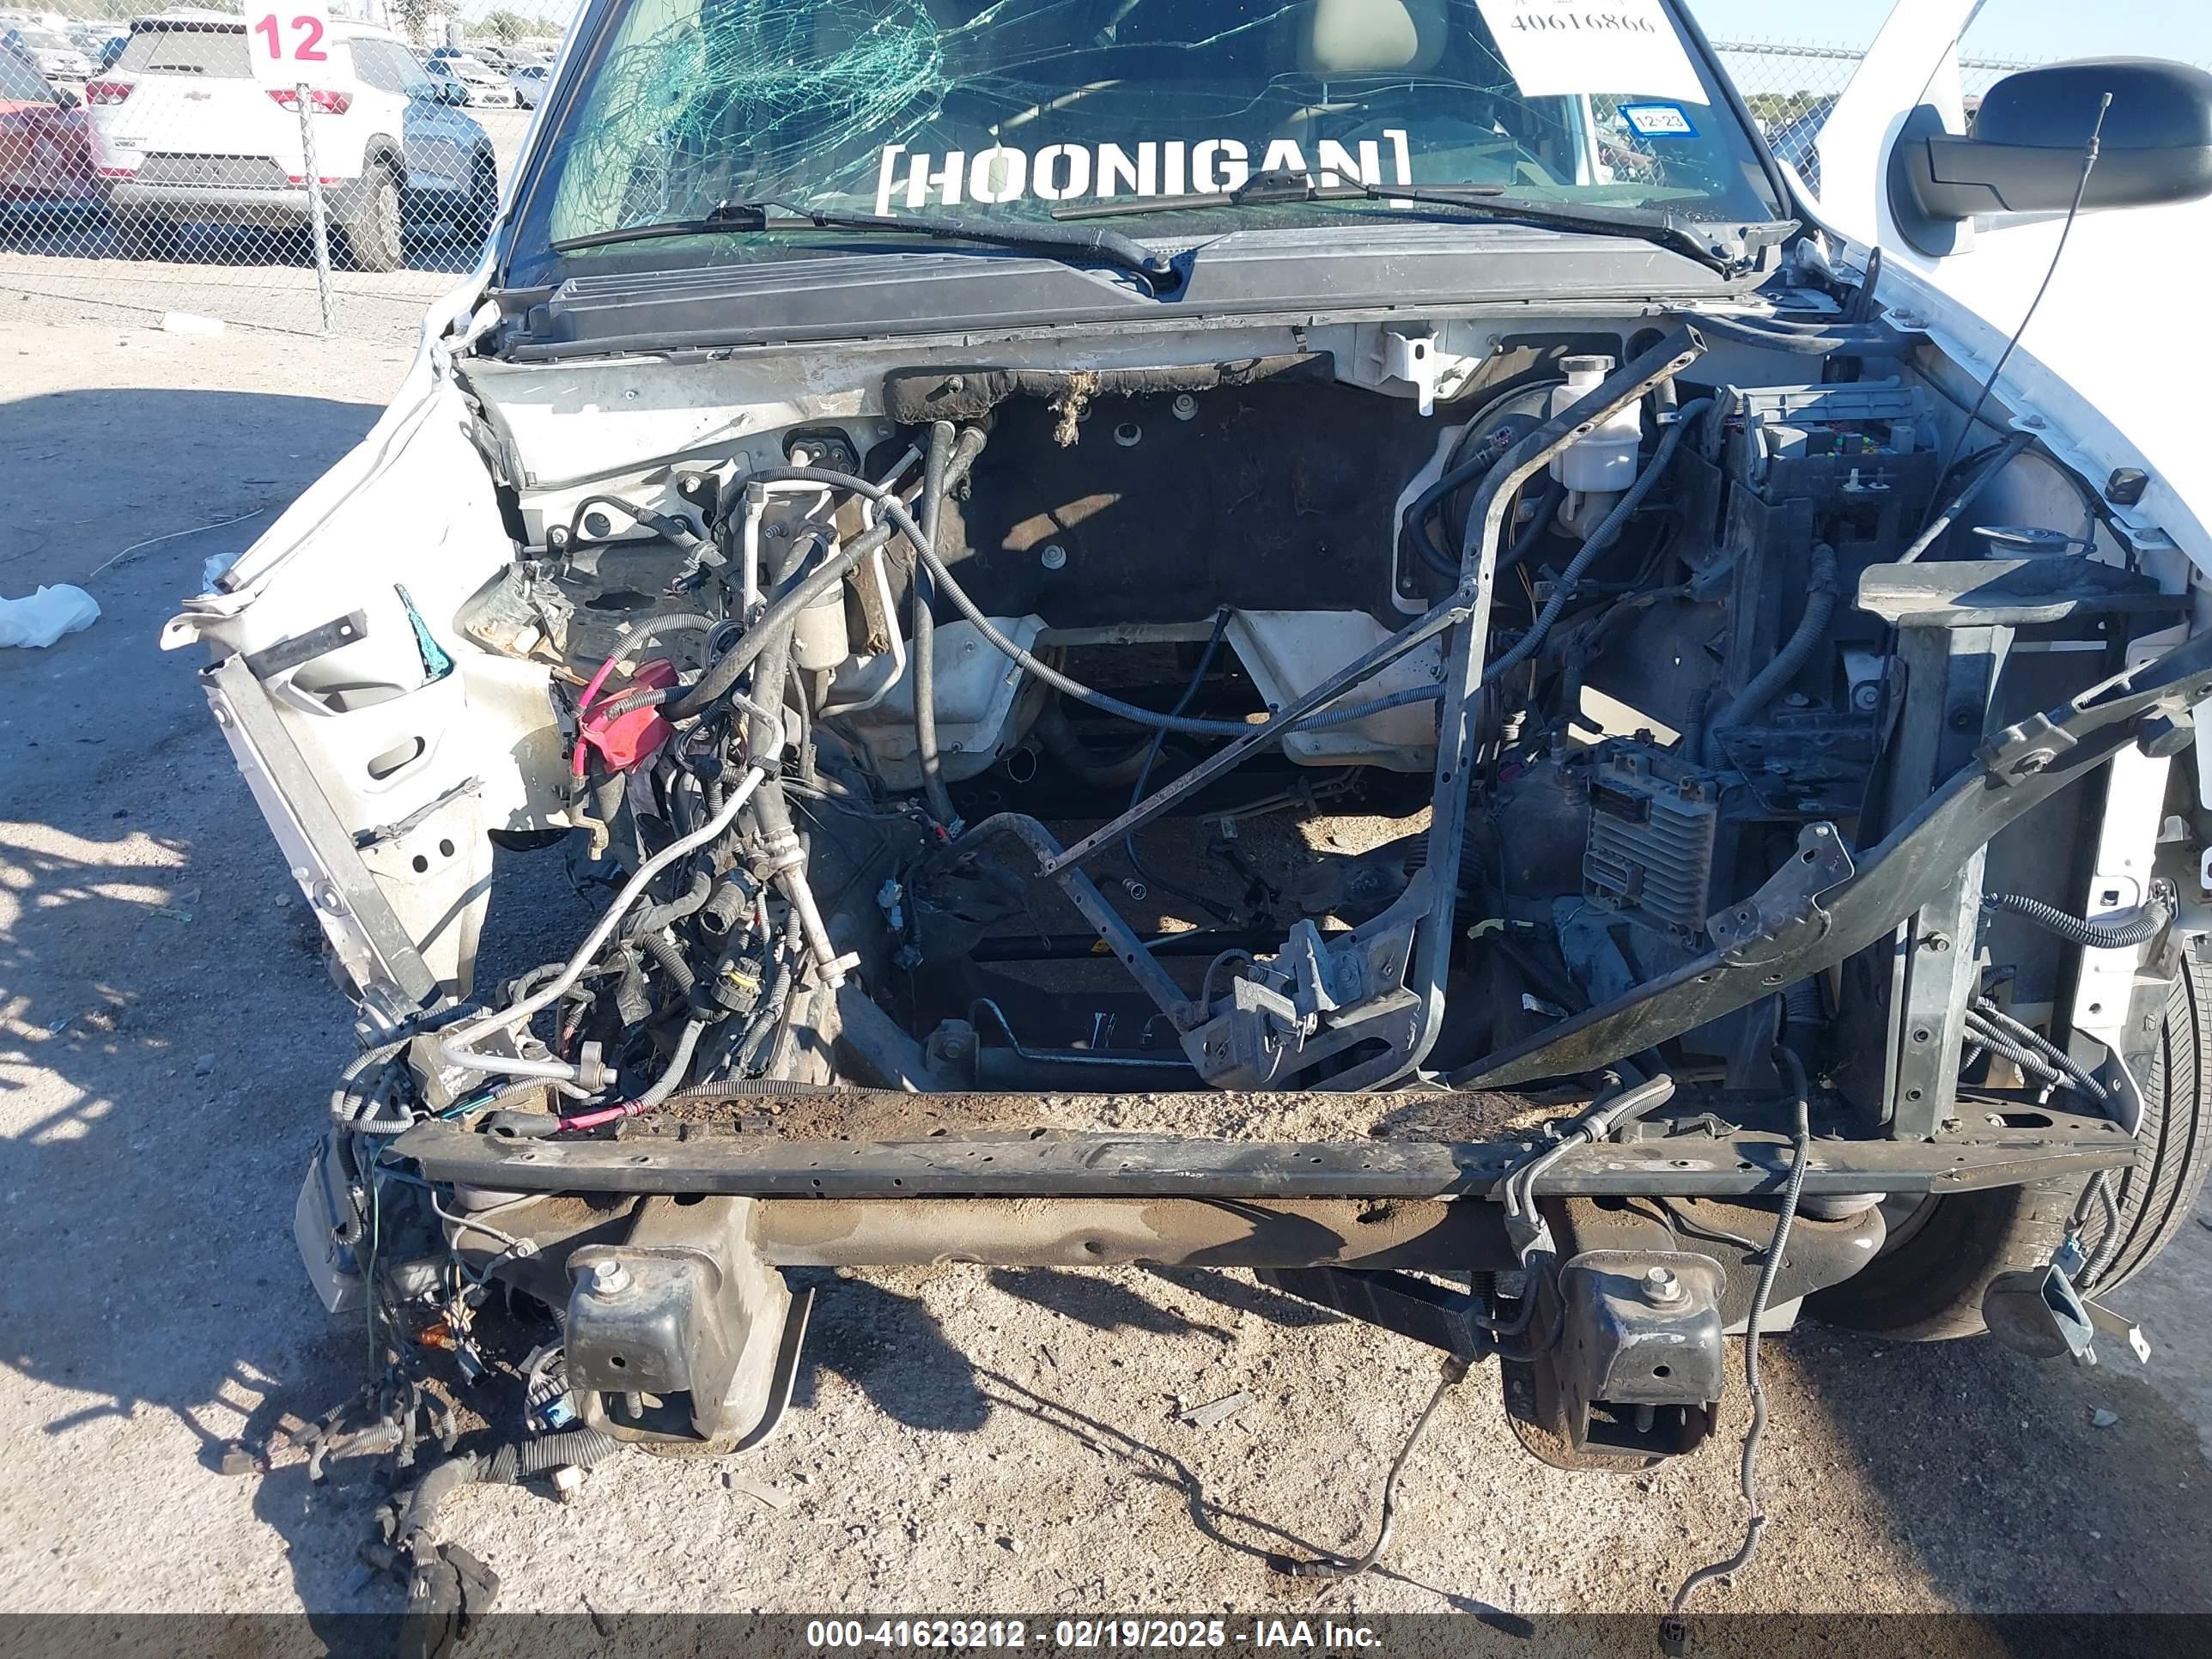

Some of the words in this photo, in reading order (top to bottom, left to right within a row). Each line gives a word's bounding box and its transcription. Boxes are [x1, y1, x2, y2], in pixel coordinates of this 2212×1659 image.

[1510, 13, 1656, 33] 40616866
[255, 15, 327, 61] 12
[1635, 115, 1684, 127] 12-23
